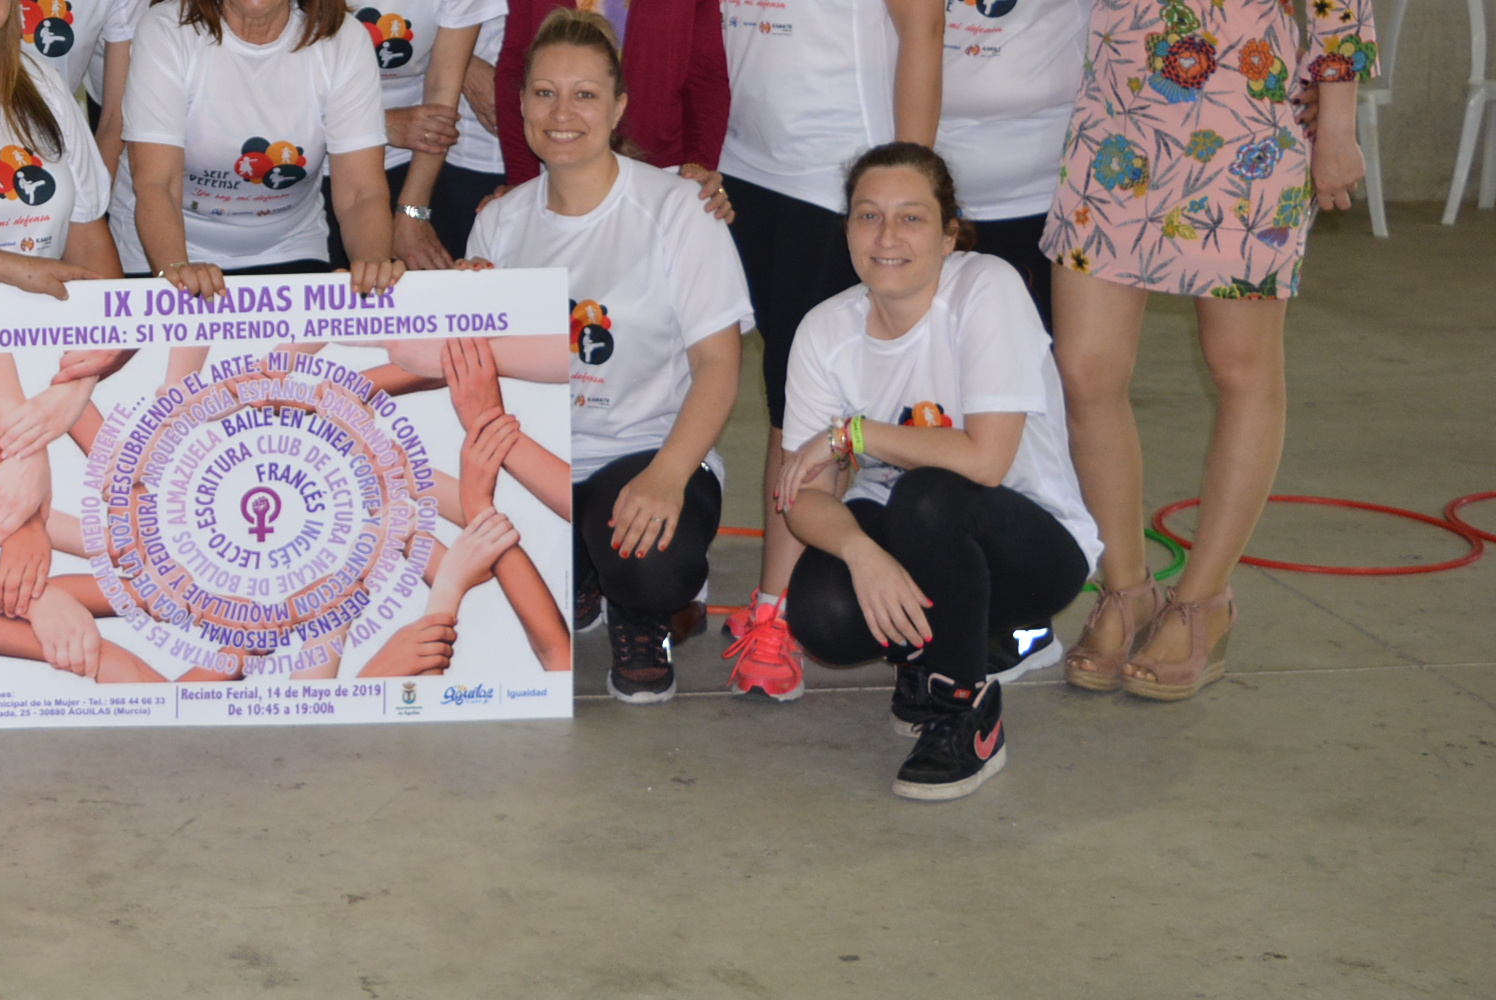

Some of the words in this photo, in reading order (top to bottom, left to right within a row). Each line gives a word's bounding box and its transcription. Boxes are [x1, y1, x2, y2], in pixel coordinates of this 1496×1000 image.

[189, 173, 242, 190] DEFENSE
[203, 170, 230, 179] SELF
[13, 214, 51, 227] defensa
[104, 290, 132, 318] IX
[143, 285, 292, 317] JORNADAS
[304, 284, 395, 311] MUJER
[136, 323, 154, 343] SI
[162, 322, 188, 342] YO
[195, 319, 296, 343] APRENDO,
[303, 315, 438, 337] APRENDEMOS
[445, 312, 509, 332] TODAS
[210, 354, 261, 383] ARTE:
[268, 352, 288, 371] MI
[294, 353, 374, 403] HISTORIA
[183, 372, 209, 396] EL
[237, 375, 317, 404] ESPAÑOL
[370, 390, 397, 418] NO
[83, 396, 146, 490] AMBIENTE...
[141, 388, 236, 488] ARQUEOLOGÍA
[221, 407, 273, 438] BAILE
[280, 407, 304, 429] EN
[307, 414, 356, 457] LÍNEA
[320, 390, 398, 467] DANZANDO
[110, 388, 184, 507] DESCUBRIENDO
[391, 416, 435, 492] CONTADA
[166, 429, 223, 525] ALMAZUELA
[255, 462, 328, 513] FRANCÉS
[257, 434, 303, 457] CLUB
[304, 445, 332, 472] DE
[323, 467, 354, 545] LECTURA
[349, 455, 382, 509] CORTE
[383, 466, 408, 501] LAS
[194, 441, 261, 570] LECTO-ESCRITURA
[361, 516, 381, 527] Y
[417, 497, 437, 531] CON
[81, 496, 105, 552] MEDIO
[109, 513, 133, 549] VOZ
[138, 493, 177, 576] PEDICURA
[268, 519, 324, 569] INGLÉS
[364, 506, 410, 593] PALABRAS
[118, 550, 144, 575] LA
[172, 530, 242, 594] BOLILLOS
[275, 547, 338, 594] ENCAJE
[294, 533, 378, 615] CONFECCIÓN
[393, 536, 434, 598] HUMOR
[89, 553, 151, 631] ESCUCHAR
[131, 573, 159, 599] DE
[168, 574, 186, 590] Y
[246, 577, 270, 597] DE
[152, 594, 195, 632] YOGA
[182, 583, 290, 623] MAQUILLAJE
[295, 590, 371, 642] DEFENSA
[377, 595, 403, 620] LO
[146, 625, 171, 648] ES
[200, 620, 291, 649] PERSONAL
[329, 637, 344, 655] A
[348, 617, 382, 648] VOY
[169, 638, 239, 673] CONTAR
[244, 645, 329, 675] EXPLICAR
[30, 699, 42, 707] de
[44, 699, 52, 707] la
[54, 698, 80, 708] Mujer
[128, 697, 139, 705] 44
[181, 687, 222, 700] Recinto
[226, 687, 262, 702] Ferial,
[267, 686, 281, 698] 14
[285, 685, 298, 698] de
[303, 685, 331, 701] Mayo
[335, 684, 348, 697] de
[352, 684, 382, 697] 2019
[228, 703, 242, 716] De
[247, 703, 280, 715] 10:45
[284, 705, 290, 714] a
[295, 702, 335, 715] 19:00h
[506, 688, 547, 699] Igualdad
[20, 708, 31, 717] 25
[68, 705, 111, 716] ÁGUILAS
[113, 706, 151, 717] (Murcia)
